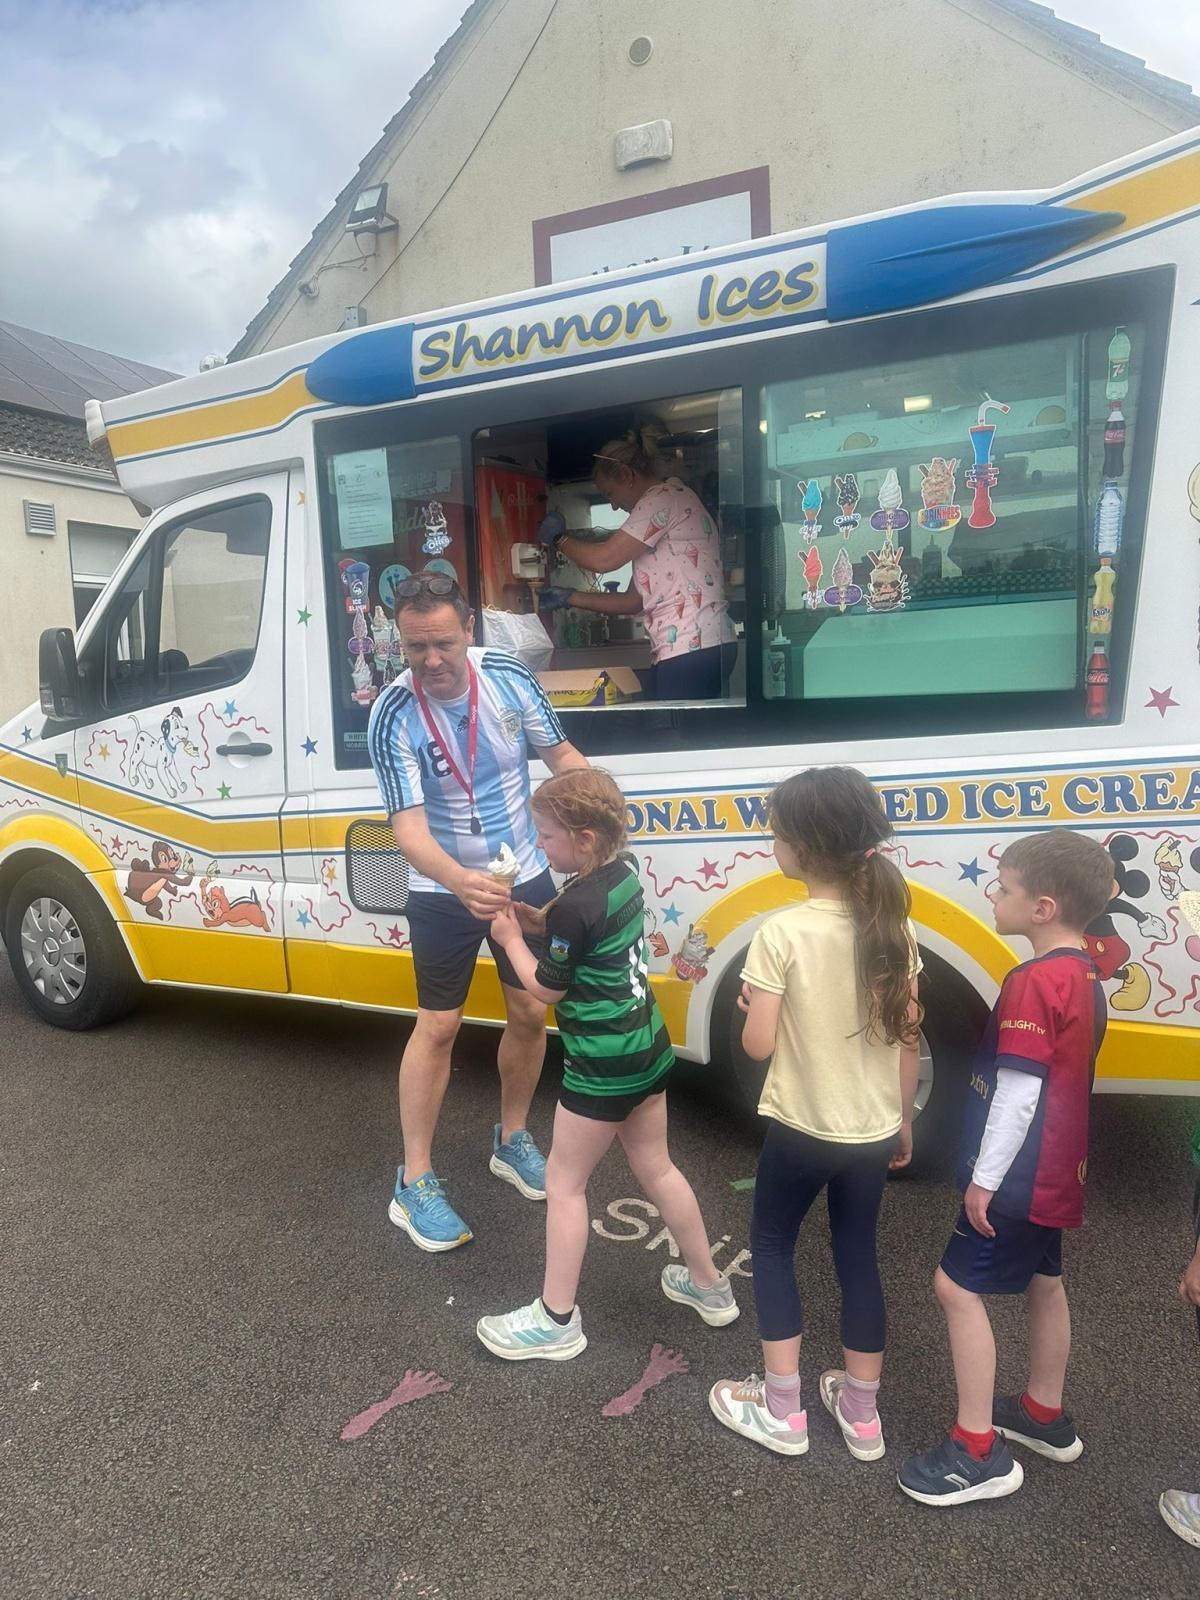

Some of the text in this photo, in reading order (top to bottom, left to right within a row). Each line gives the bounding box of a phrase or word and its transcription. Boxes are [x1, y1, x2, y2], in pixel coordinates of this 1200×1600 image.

[418, 261, 819, 381] Shannon Ices
[417, 738, 453, 779] 18
[960, 778, 1051, 819] ICE
